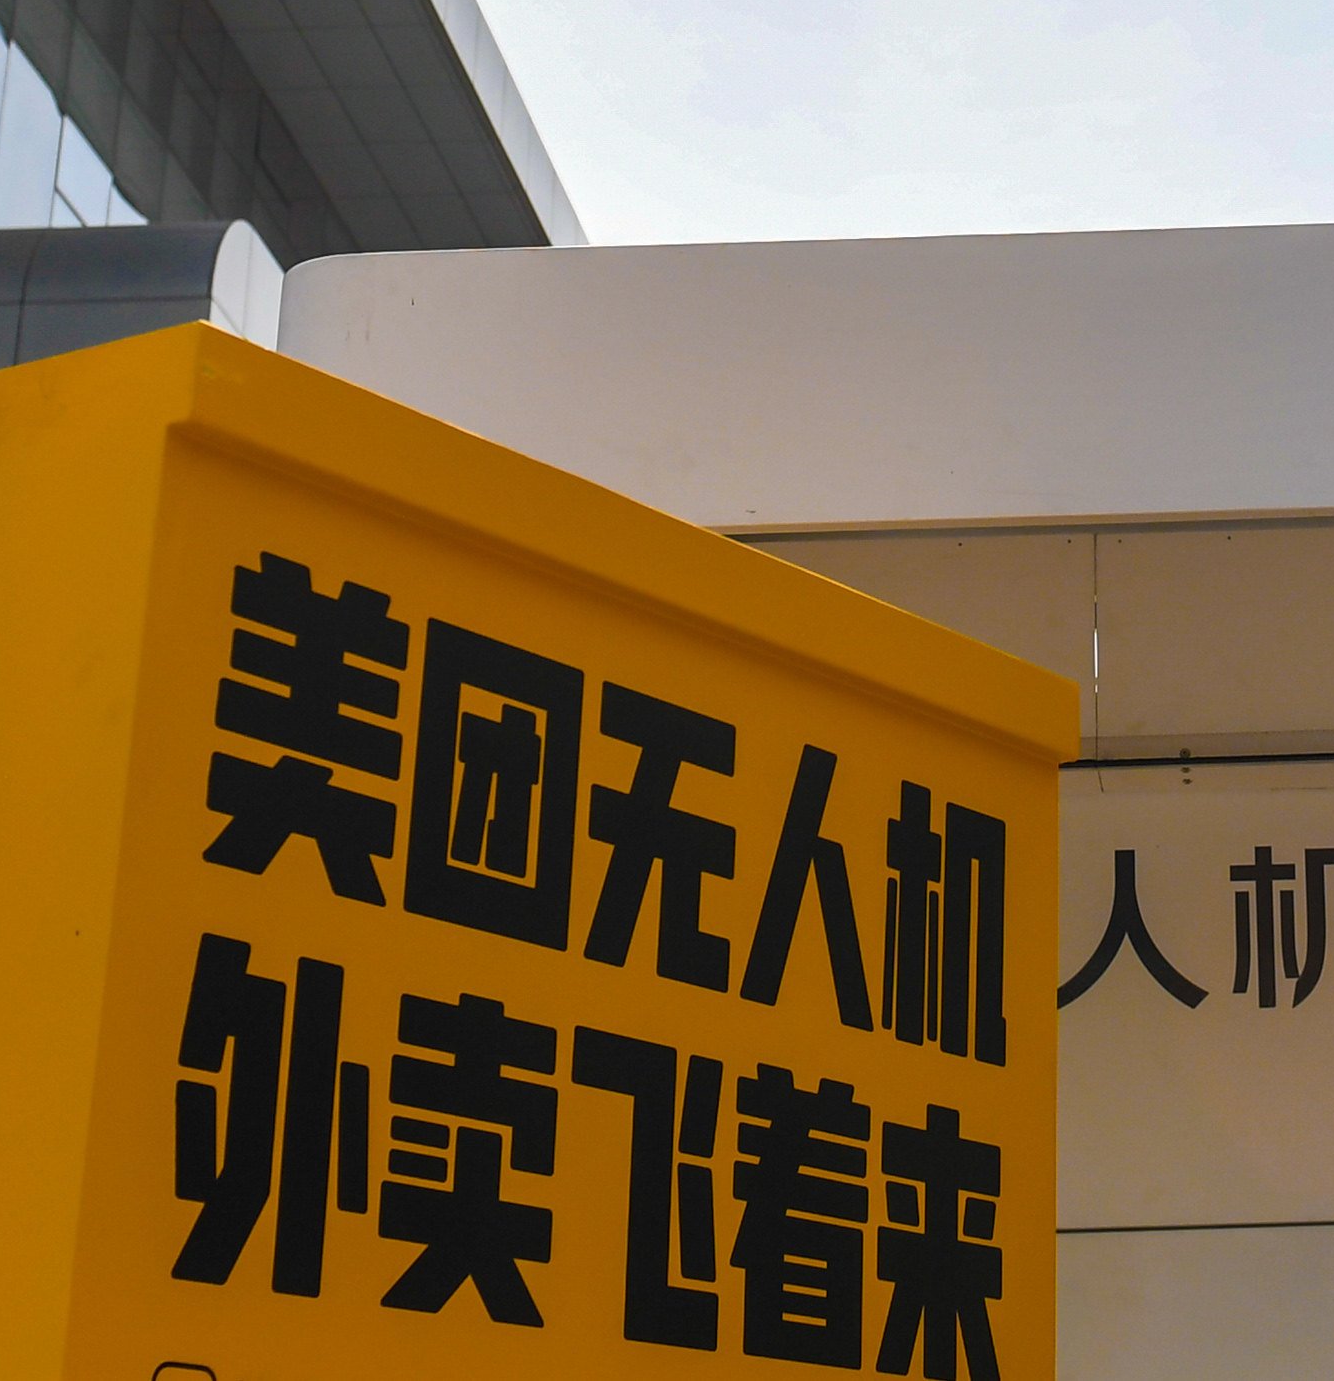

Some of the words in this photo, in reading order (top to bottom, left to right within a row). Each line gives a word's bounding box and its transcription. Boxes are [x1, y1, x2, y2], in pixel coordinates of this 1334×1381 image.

[203, 550, 1007, 1068] 美团无人机
[171, 932, 1003, 1381] 外卖飞着来
